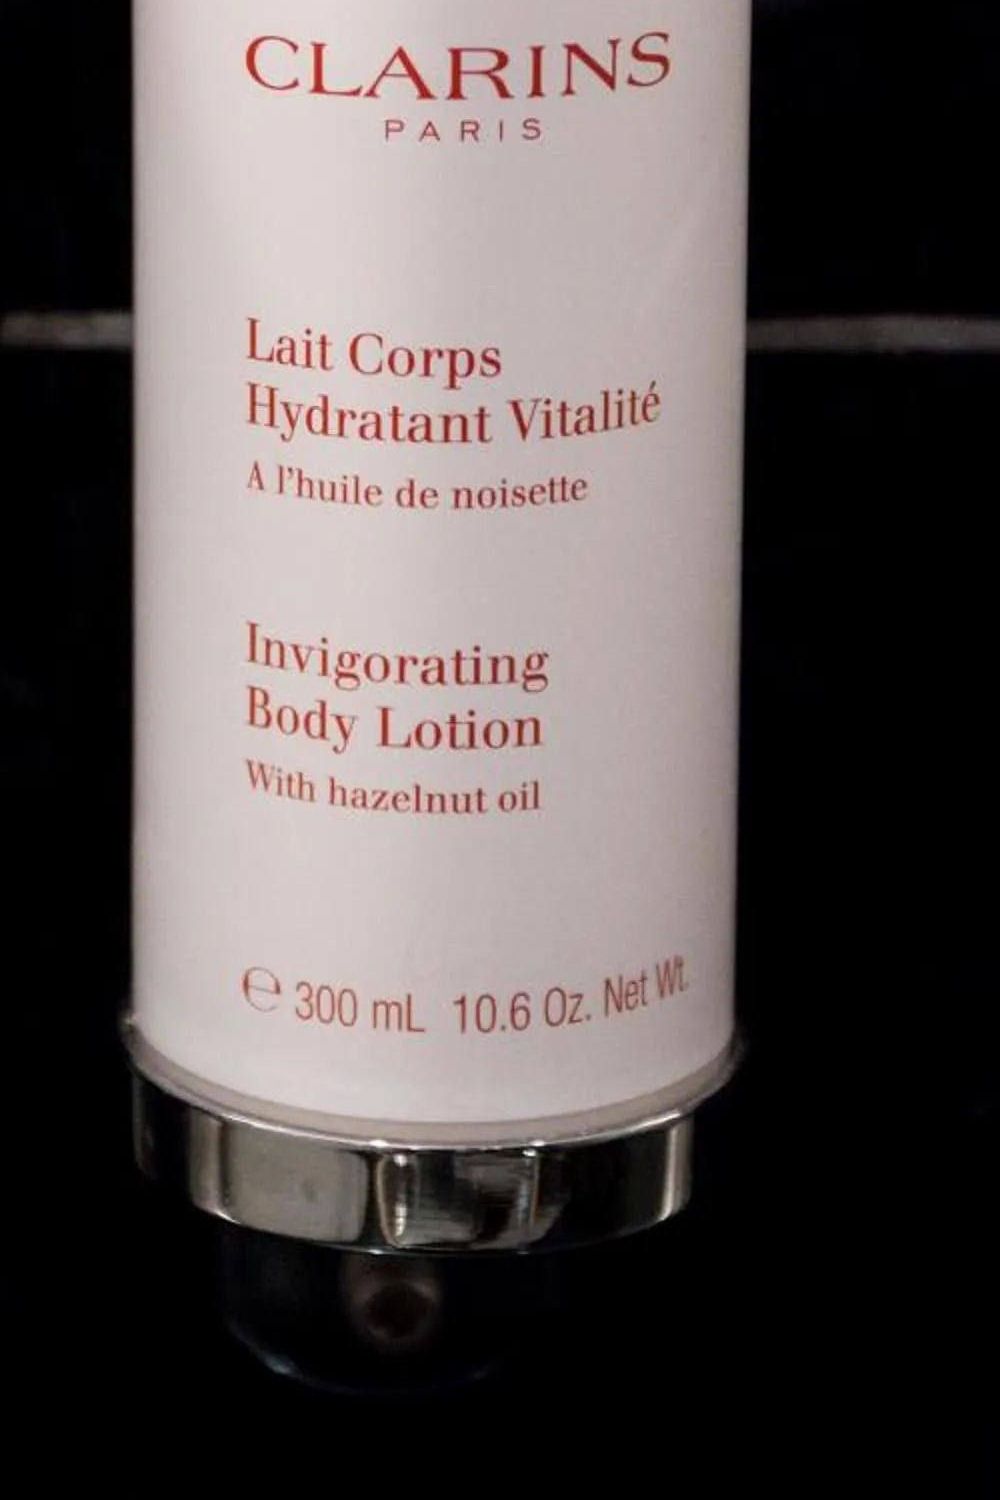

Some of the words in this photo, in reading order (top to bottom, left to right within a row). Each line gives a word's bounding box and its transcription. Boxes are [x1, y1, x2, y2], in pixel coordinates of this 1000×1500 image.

[245, 32, 671, 101] CLARINS
[384, 118, 542, 142] PARIS
[247, 317, 333, 372] Lait
[348, 333, 502, 390] Corps
[246, 382, 493, 443] Hydratant
[507, 380, 661, 442] Vitalité
[246, 460, 265, 490] A
[395, 479, 440, 509] de
[452, 475, 589, 510] noisette
[246, 620, 549, 693] Invigorating
[246, 685, 358, 755] Body
[376, 706, 542, 750] Lotion
[246, 759, 316, 803] With
[328, 776, 488, 815] hazelnut
[498, 781, 542, 812] oil
[294, 981, 359, 1028] 300
[372, 993, 426, 1034] mL
[453, 991, 531, 1034] 10.6
[544, 986, 592, 1028] Oz.
[603, 969, 649, 1017] Net
